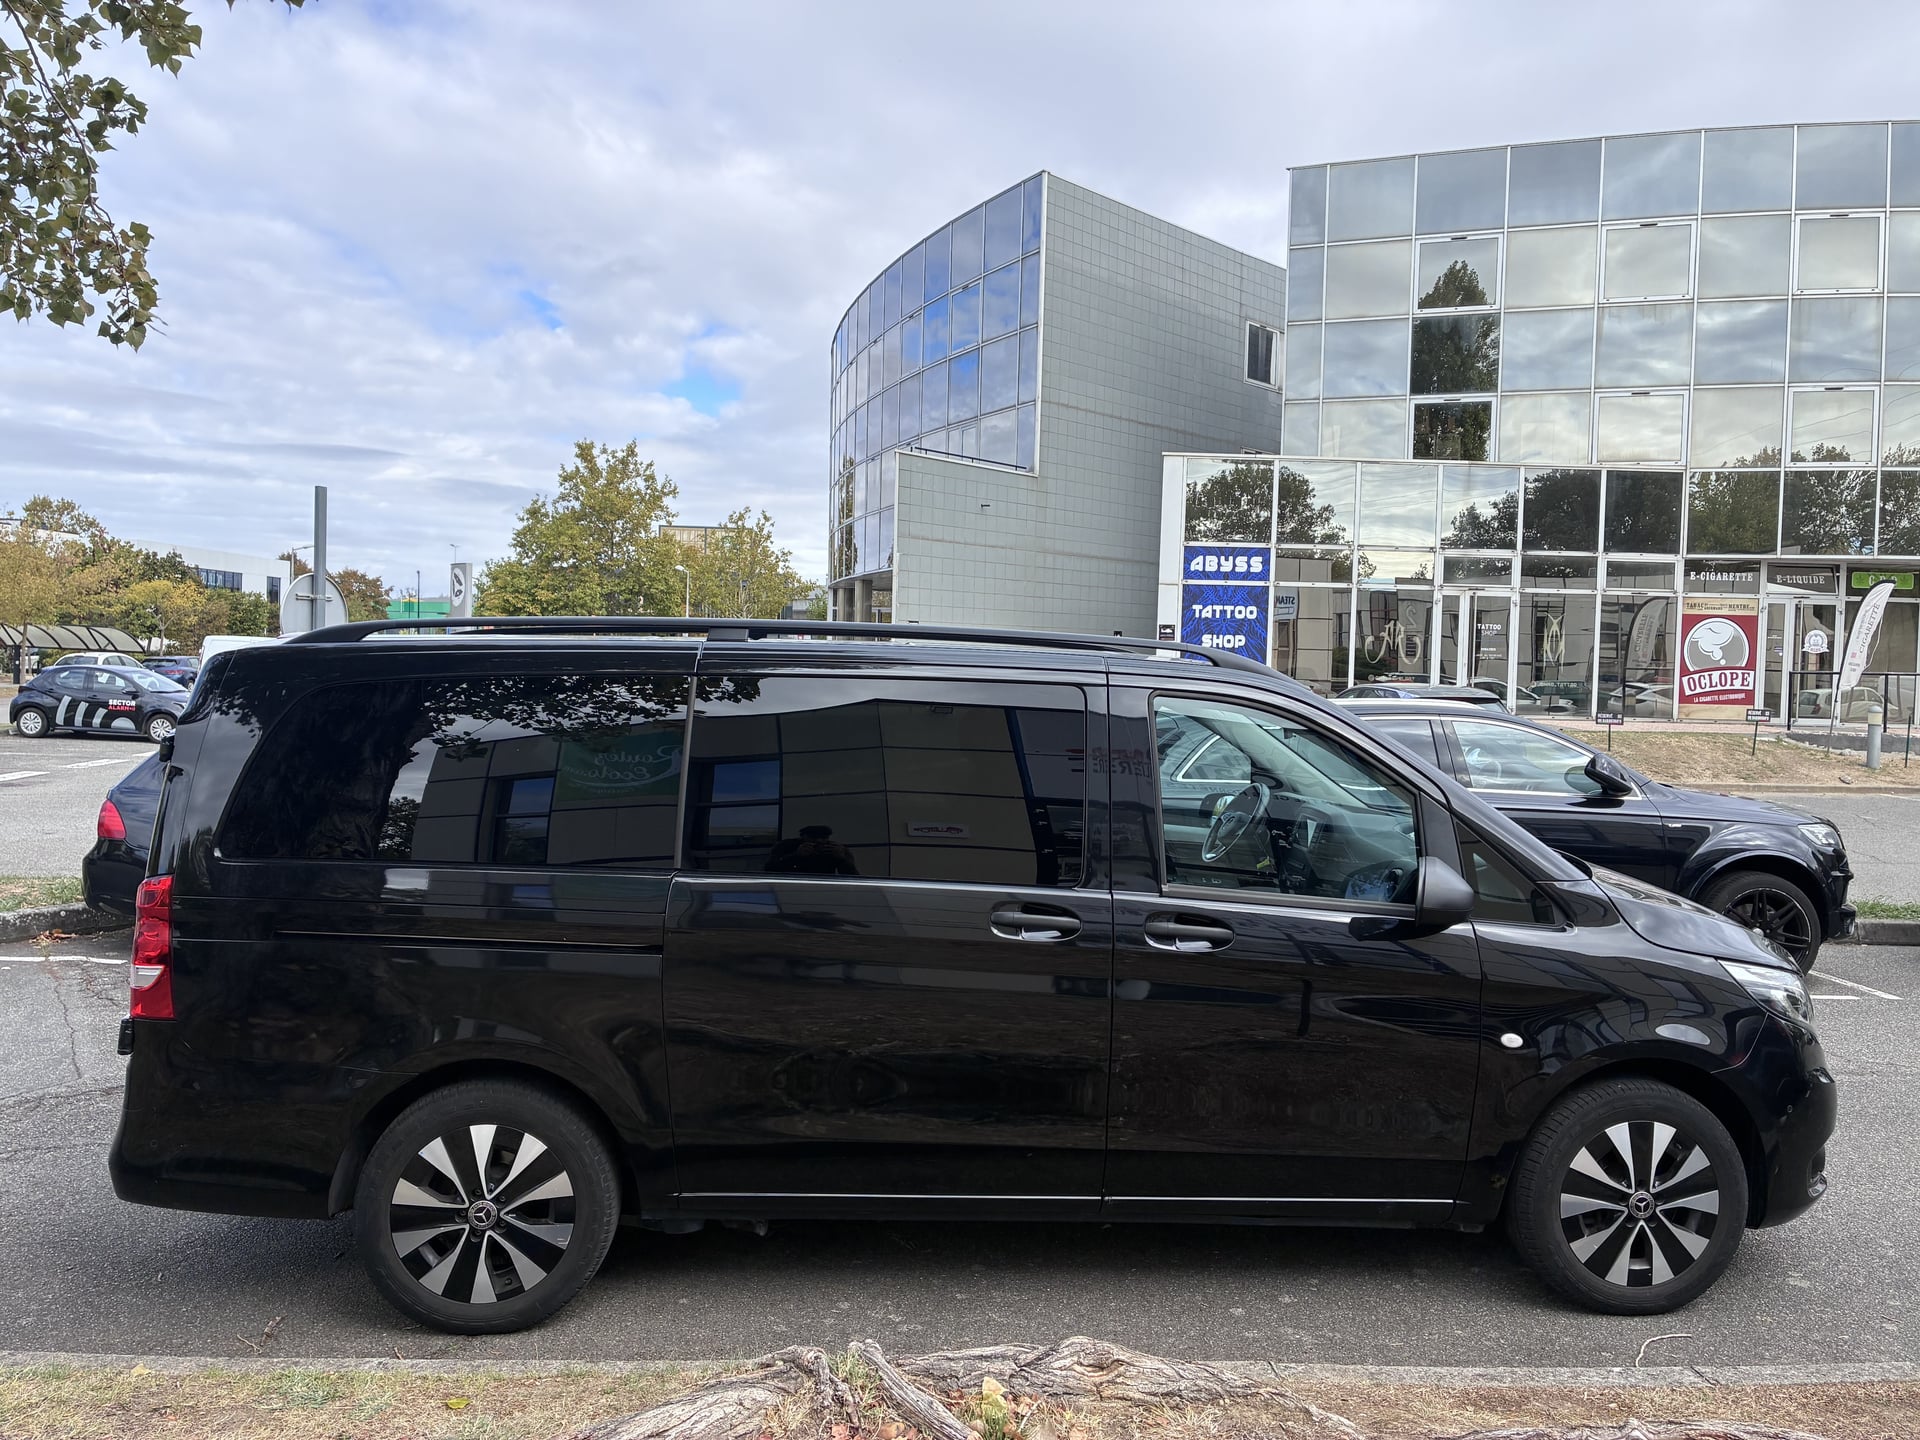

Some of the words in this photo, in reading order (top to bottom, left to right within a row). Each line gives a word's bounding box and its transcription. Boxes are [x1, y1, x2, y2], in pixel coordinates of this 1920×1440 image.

[1190, 555, 1263, 573] ABYSS
[1690, 571, 1753, 582] E-CIGARETTE
[1776, 574, 1825, 584] E-LIQUIDE
[1192, 604, 1258, 619] TATTOO
[1477, 623, 1502, 631] TATTOO
[1859, 602, 1881, 654] CIGARETTE
[1201, 634, 1246, 649] SHOP
[1687, 671, 1751, 692] OCLOPE
